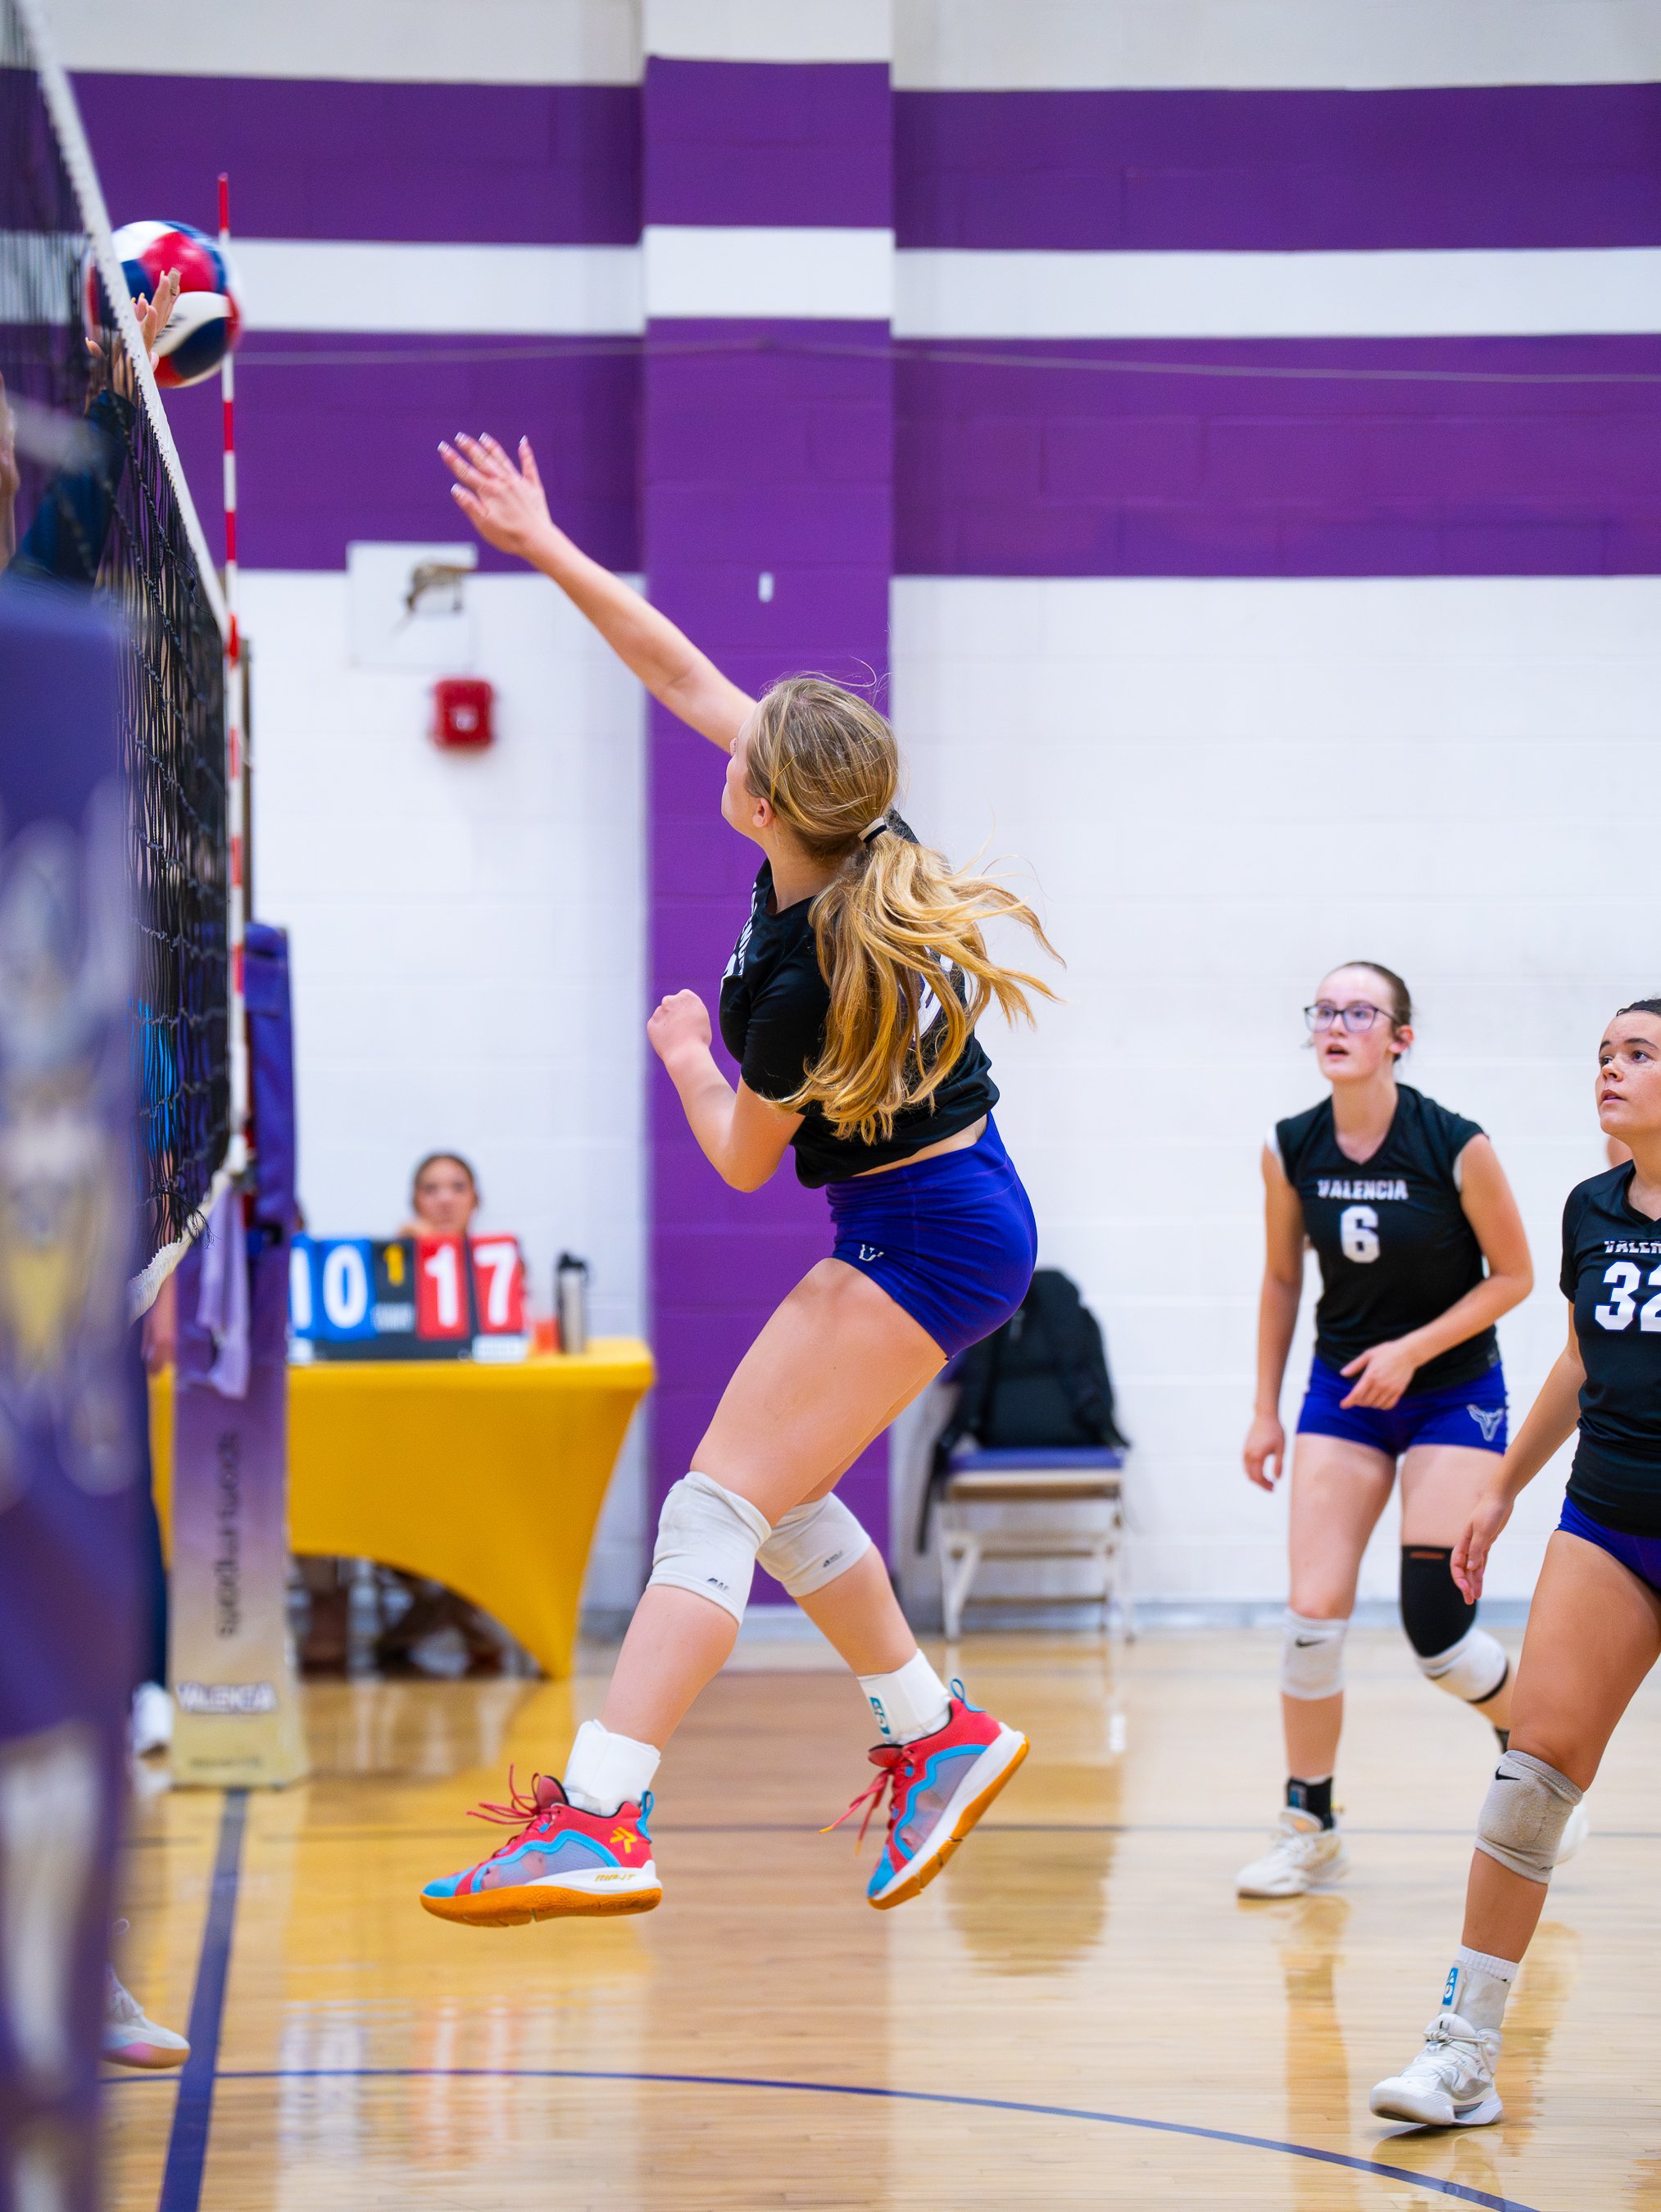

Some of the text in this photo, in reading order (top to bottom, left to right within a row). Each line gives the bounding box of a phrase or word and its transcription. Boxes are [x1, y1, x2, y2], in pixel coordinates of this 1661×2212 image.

[1317, 1179, 1409, 1200] VALENCIA
[1340, 1205, 1381, 1264] 6
[383, 1244, 404, 1287] 1
[424, 1241, 518, 1328] 17
